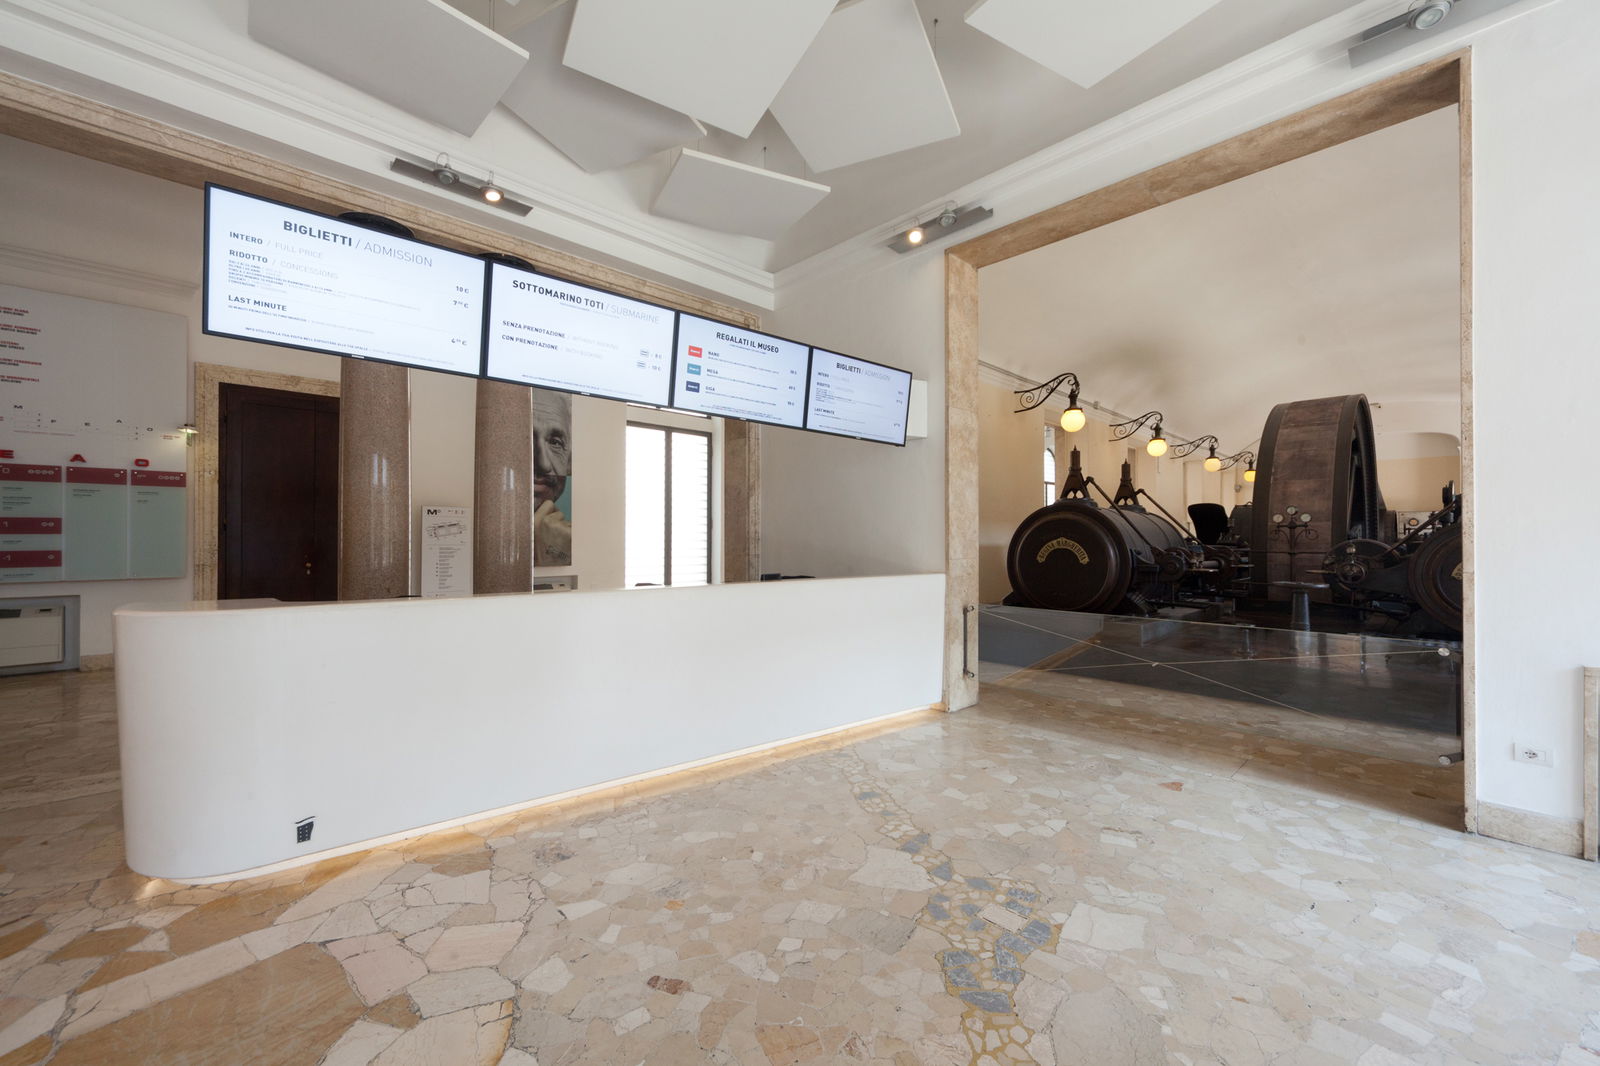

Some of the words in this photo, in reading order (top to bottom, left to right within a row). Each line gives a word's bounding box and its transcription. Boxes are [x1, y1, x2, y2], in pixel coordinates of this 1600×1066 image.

[229, 231, 263, 245] INTERO
[275, 241, 296, 253] FULL
[283, 220, 352, 247] BIGLIETTI
[364, 241, 433, 267] ADMISSION
[229, 249, 268, 264] RIDOTTO
[228, 294, 251, 304] LAST
[253, 299, 288, 312] MINUTE
[512, 280, 582, 304] SOTTOMARINO
[585, 298, 604, 310] TOTI
[611, 304, 660, 324] SUBMARINE
[503, 320, 522, 329] SENZA
[523, 324, 565, 339] PRENOTAZIONE
[502, 334, 514, 342] CON
[516, 337, 558, 350] PRENOTAZIONE
[716, 332, 749, 346] REGALATI
[757, 342, 779, 353] MUSEO
[836, 362, 861, 374] BIGLIETTI
[69, 454, 86, 463] A
